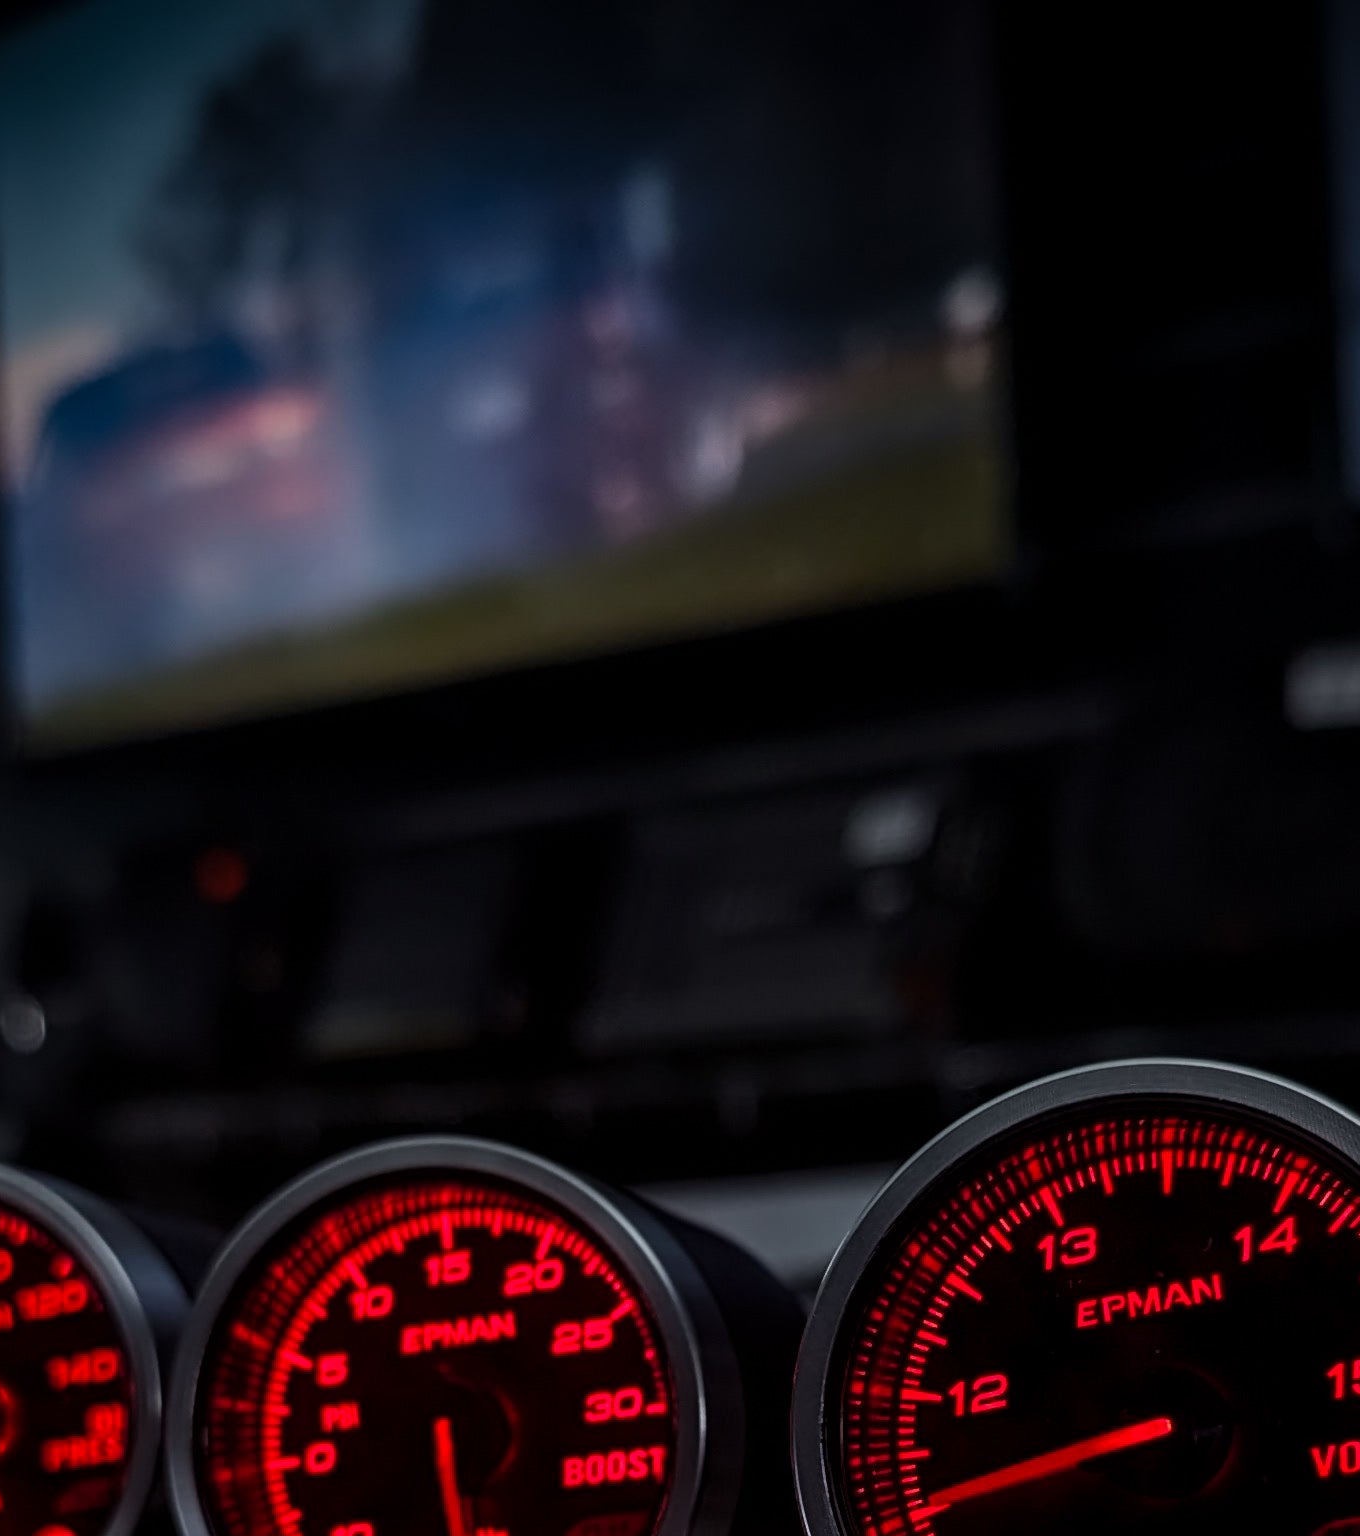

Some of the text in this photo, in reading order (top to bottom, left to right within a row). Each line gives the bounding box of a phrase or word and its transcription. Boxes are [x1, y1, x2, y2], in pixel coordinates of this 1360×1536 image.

[1037, 1227, 1098, 1271] 13
[1233, 1217, 1297, 1262] 14
[425, 1251, 472, 1286] 15
[504, 1260, 563, 1297] 20
[350, 1287, 395, 1321] 10
[1075, 1271, 1223, 1329] EPMAN
[401, 1310, 517, 1356] EPMAN
[551, 1317, 613, 1356] 25
[584, 1388, 641, 1422] 30
[948, 1372, 1009, 1416] 12
[305, 1442, 336, 1475] 0
[561, 1446, 666, 1488] BOOST
